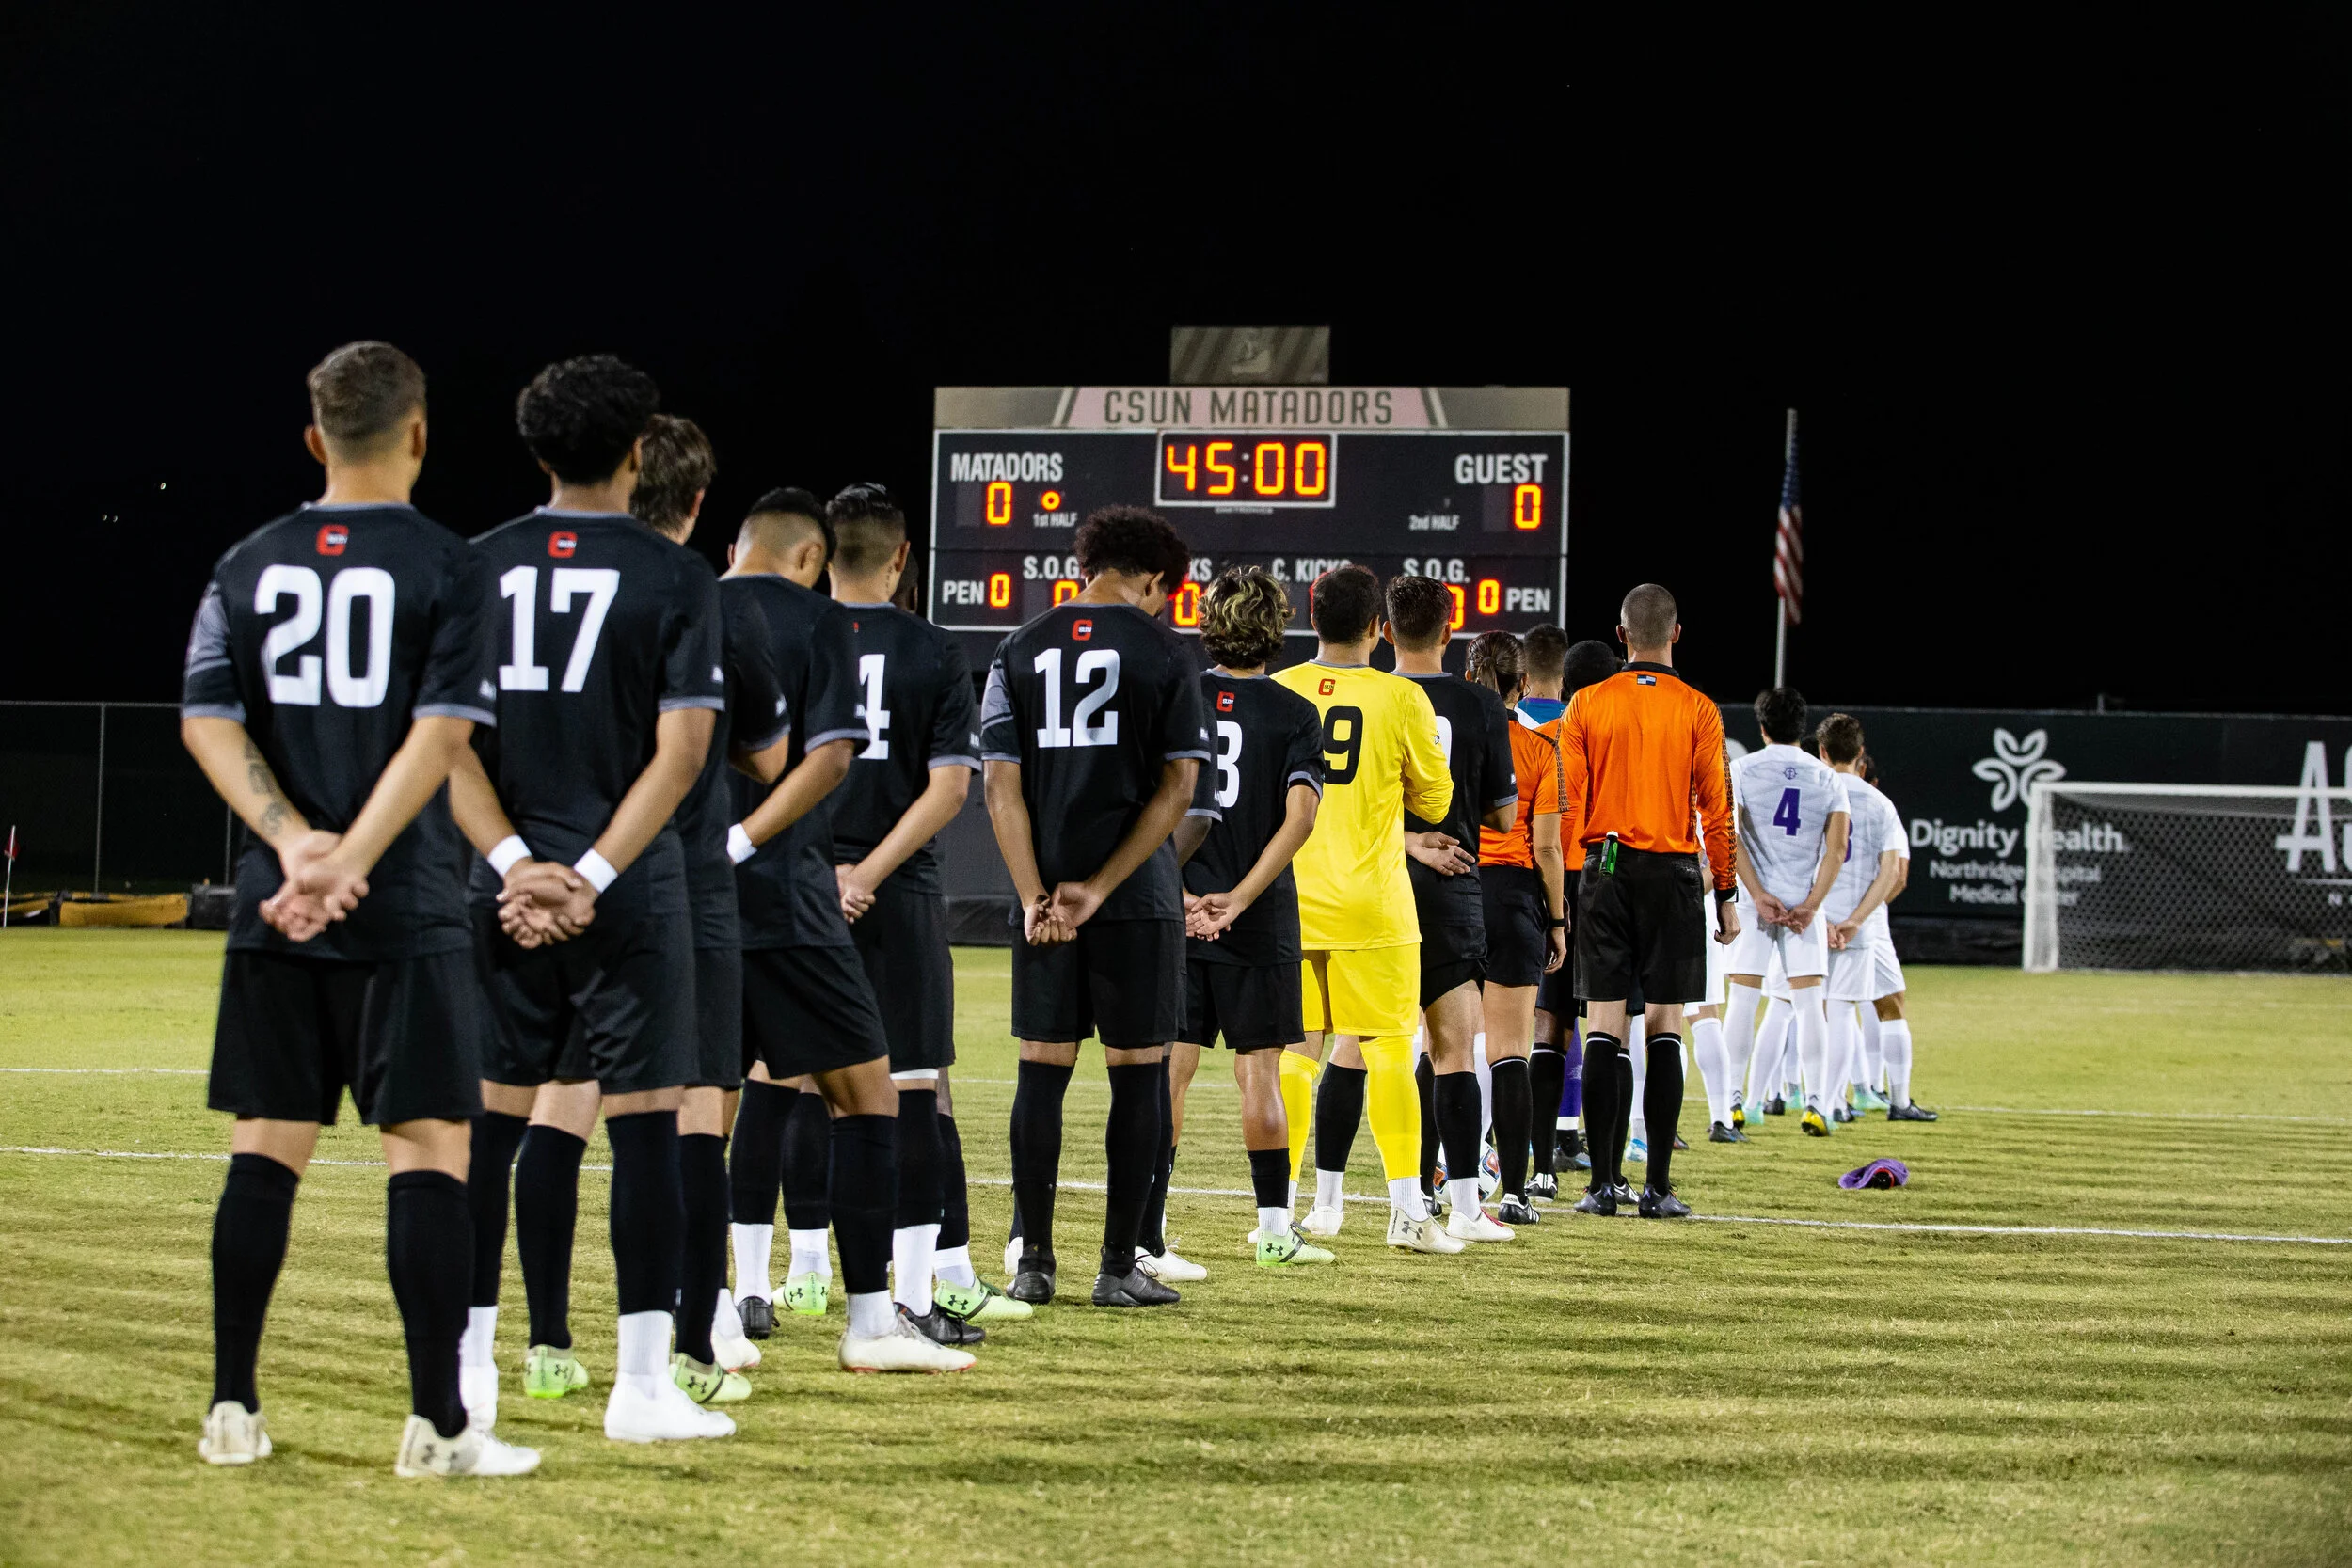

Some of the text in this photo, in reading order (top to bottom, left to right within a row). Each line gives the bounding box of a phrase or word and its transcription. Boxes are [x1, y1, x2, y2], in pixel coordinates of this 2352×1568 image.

[1104, 391, 1392, 425] CSUN MATADORS
[950, 452, 1064, 483] MATADORS
[1166, 441, 1326, 496] 45:00
[1454, 453, 1549, 484] GUEST
[987, 481, 1013, 526] 0
[1514, 483, 1542, 530] 0
[943, 580, 985, 605] PEN
[990, 573, 1010, 608] 0
[1477, 578, 1500, 614] 0
[1506, 588, 1550, 611] PEN
[254, 564, 395, 708] 20
[499, 565, 621, 692] 17
[1034, 648, 1120, 749] 12
[1773, 787, 1802, 836] 4
[2275, 740, 2352, 873] A
[1910, 819, 2124, 858] Dignity ealth
